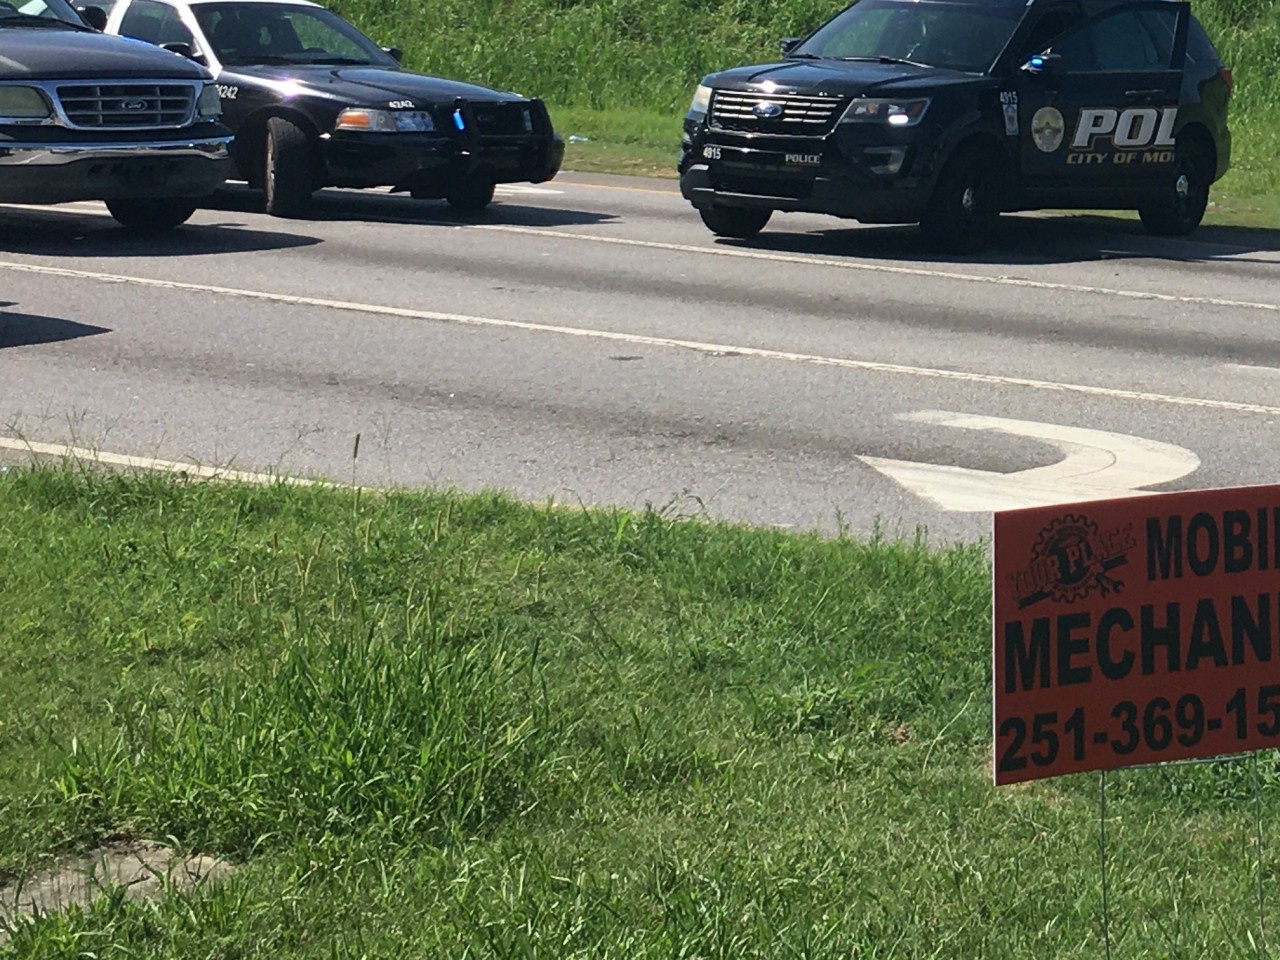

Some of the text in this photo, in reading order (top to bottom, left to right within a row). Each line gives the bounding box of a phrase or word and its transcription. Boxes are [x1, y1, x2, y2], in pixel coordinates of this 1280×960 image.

[1000, 91, 1018, 104] 4915
[702, 147, 722, 160] 4915
[785, 153, 820, 164] POLICE
[1066, 152, 1108, 164] CITY
[1113, 152, 1137, 163] OF
